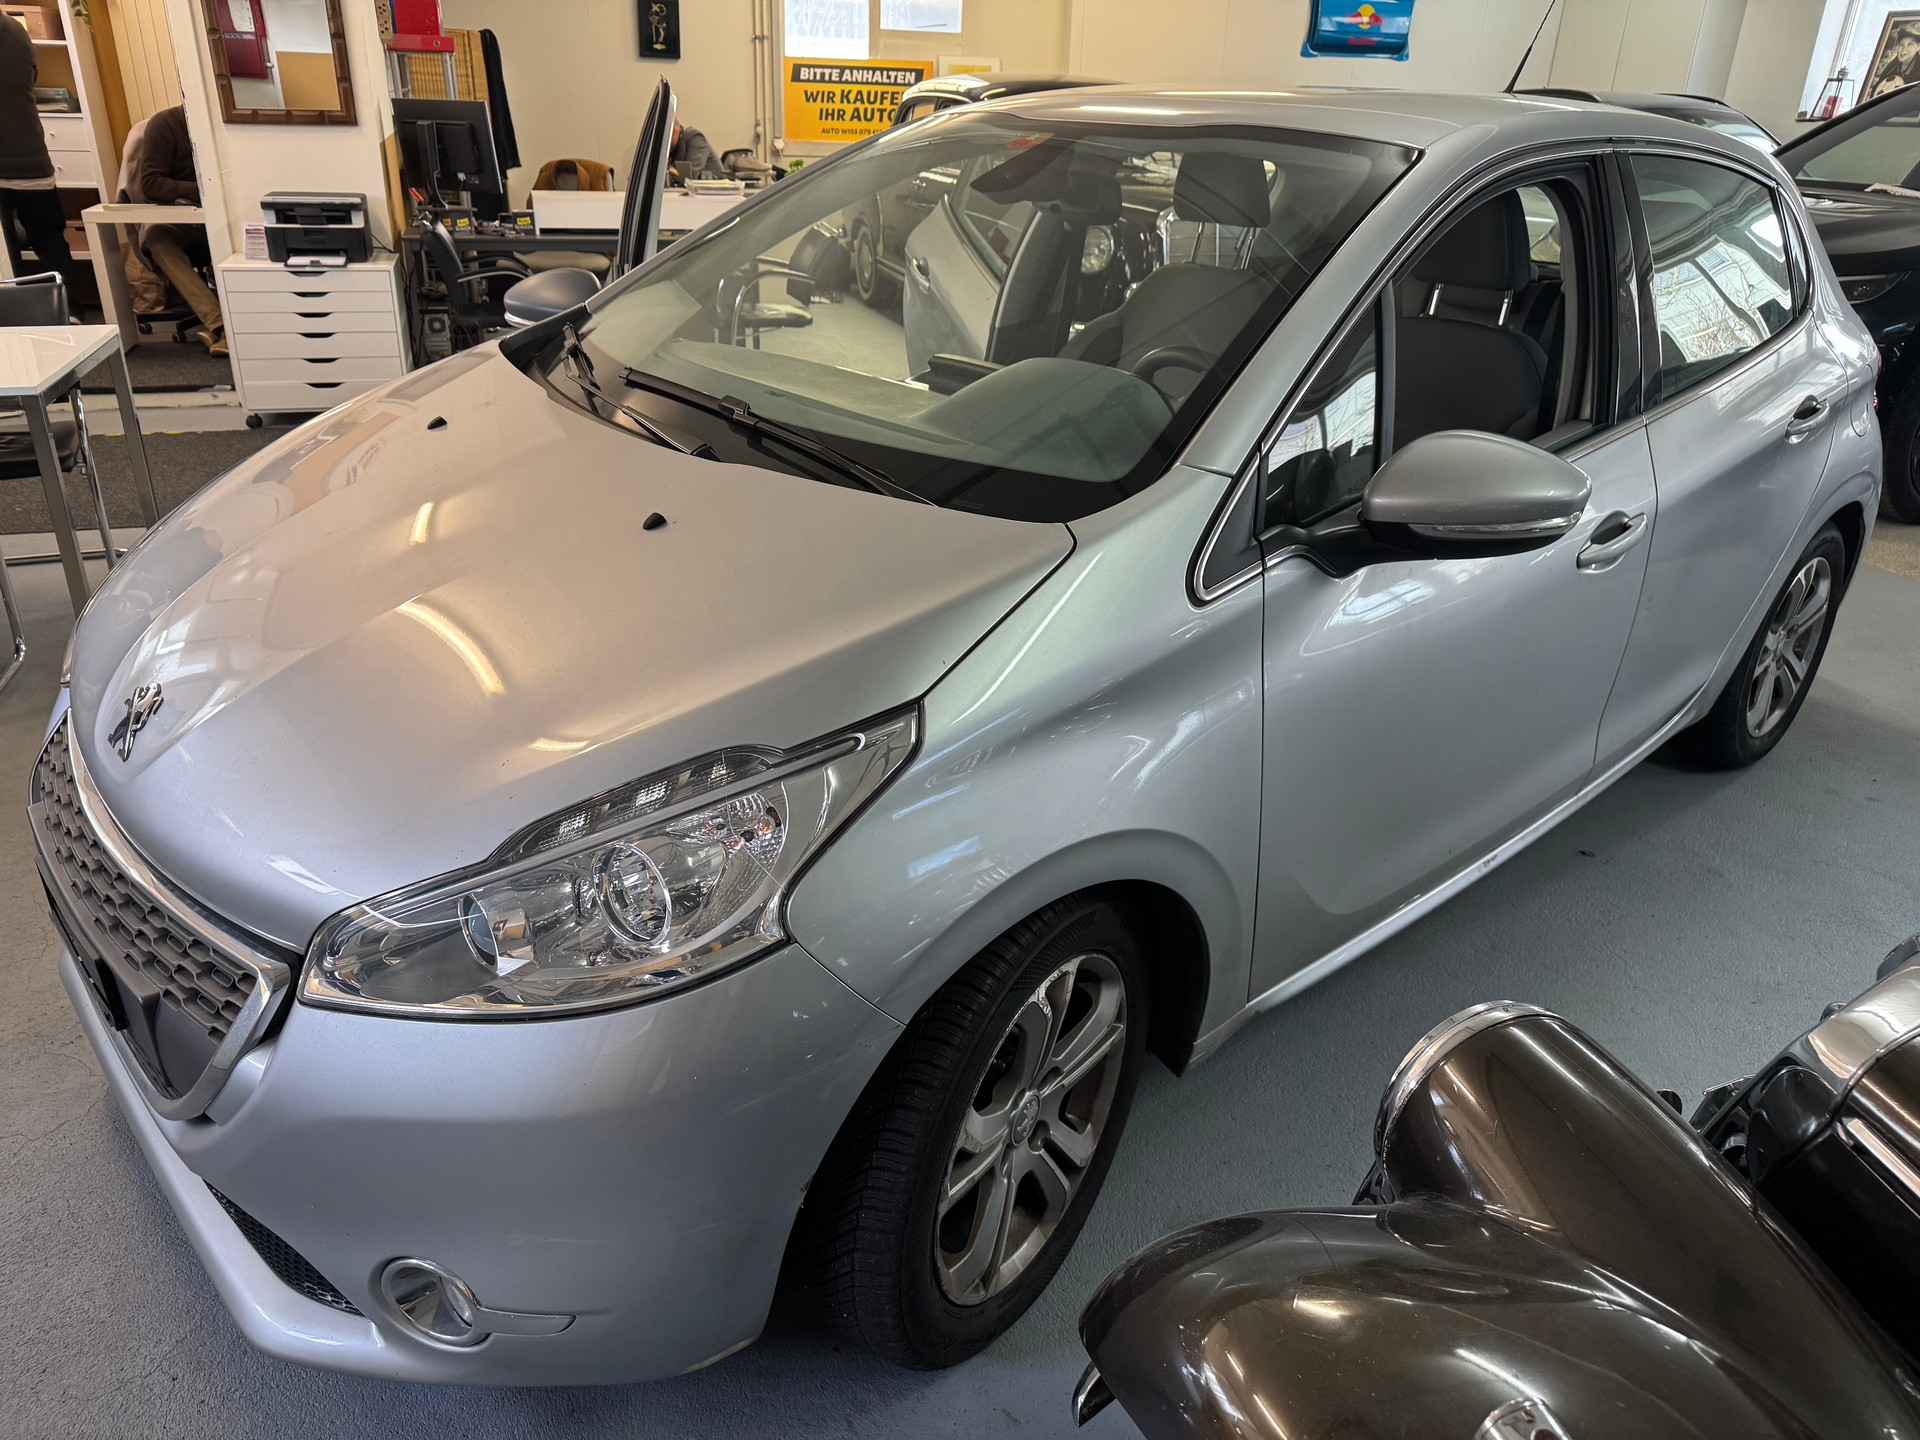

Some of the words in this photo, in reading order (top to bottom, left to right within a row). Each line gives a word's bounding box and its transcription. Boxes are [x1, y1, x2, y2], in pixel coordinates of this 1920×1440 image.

[800, 67, 840, 81] BITTE
[841, 69, 916, 84] ANHALTEN
[803, 90, 836, 104] WIR
[840, 89, 903, 105] KAUFE
[818, 108, 846, 121] IHR
[821, 127, 840, 135] AUTO
